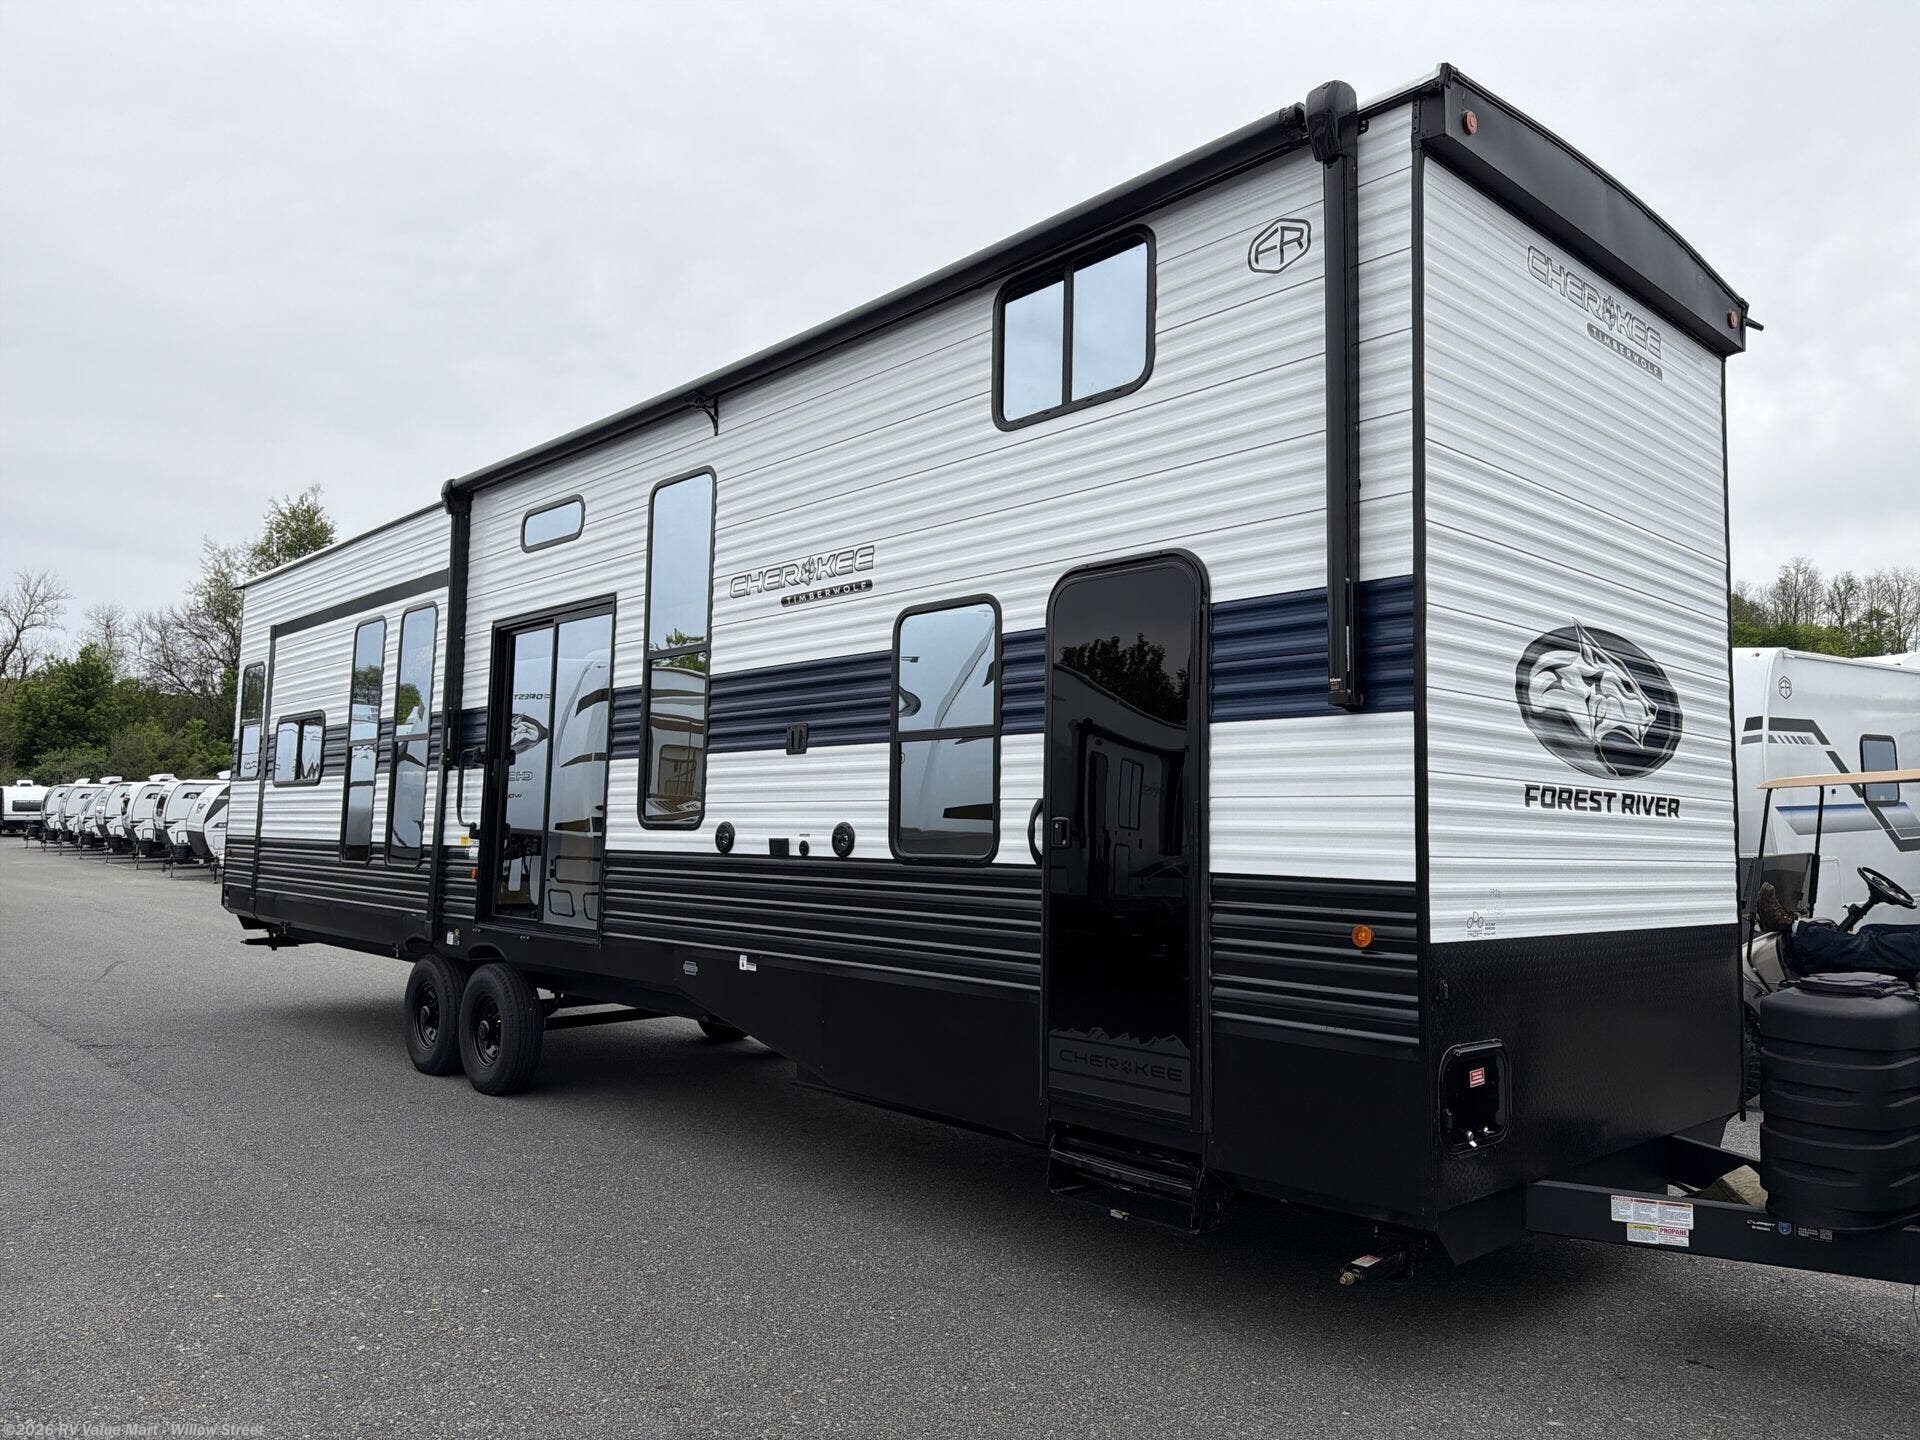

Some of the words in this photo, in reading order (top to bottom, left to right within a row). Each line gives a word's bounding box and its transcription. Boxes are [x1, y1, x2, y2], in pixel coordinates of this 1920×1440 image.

[1590, 326, 1660, 376] TIMBERWOLF
[784, 581, 868, 604] TIMBERWOLF
[1524, 784, 1617, 813] FOREST
[1621, 793, 1681, 818] RIVER
